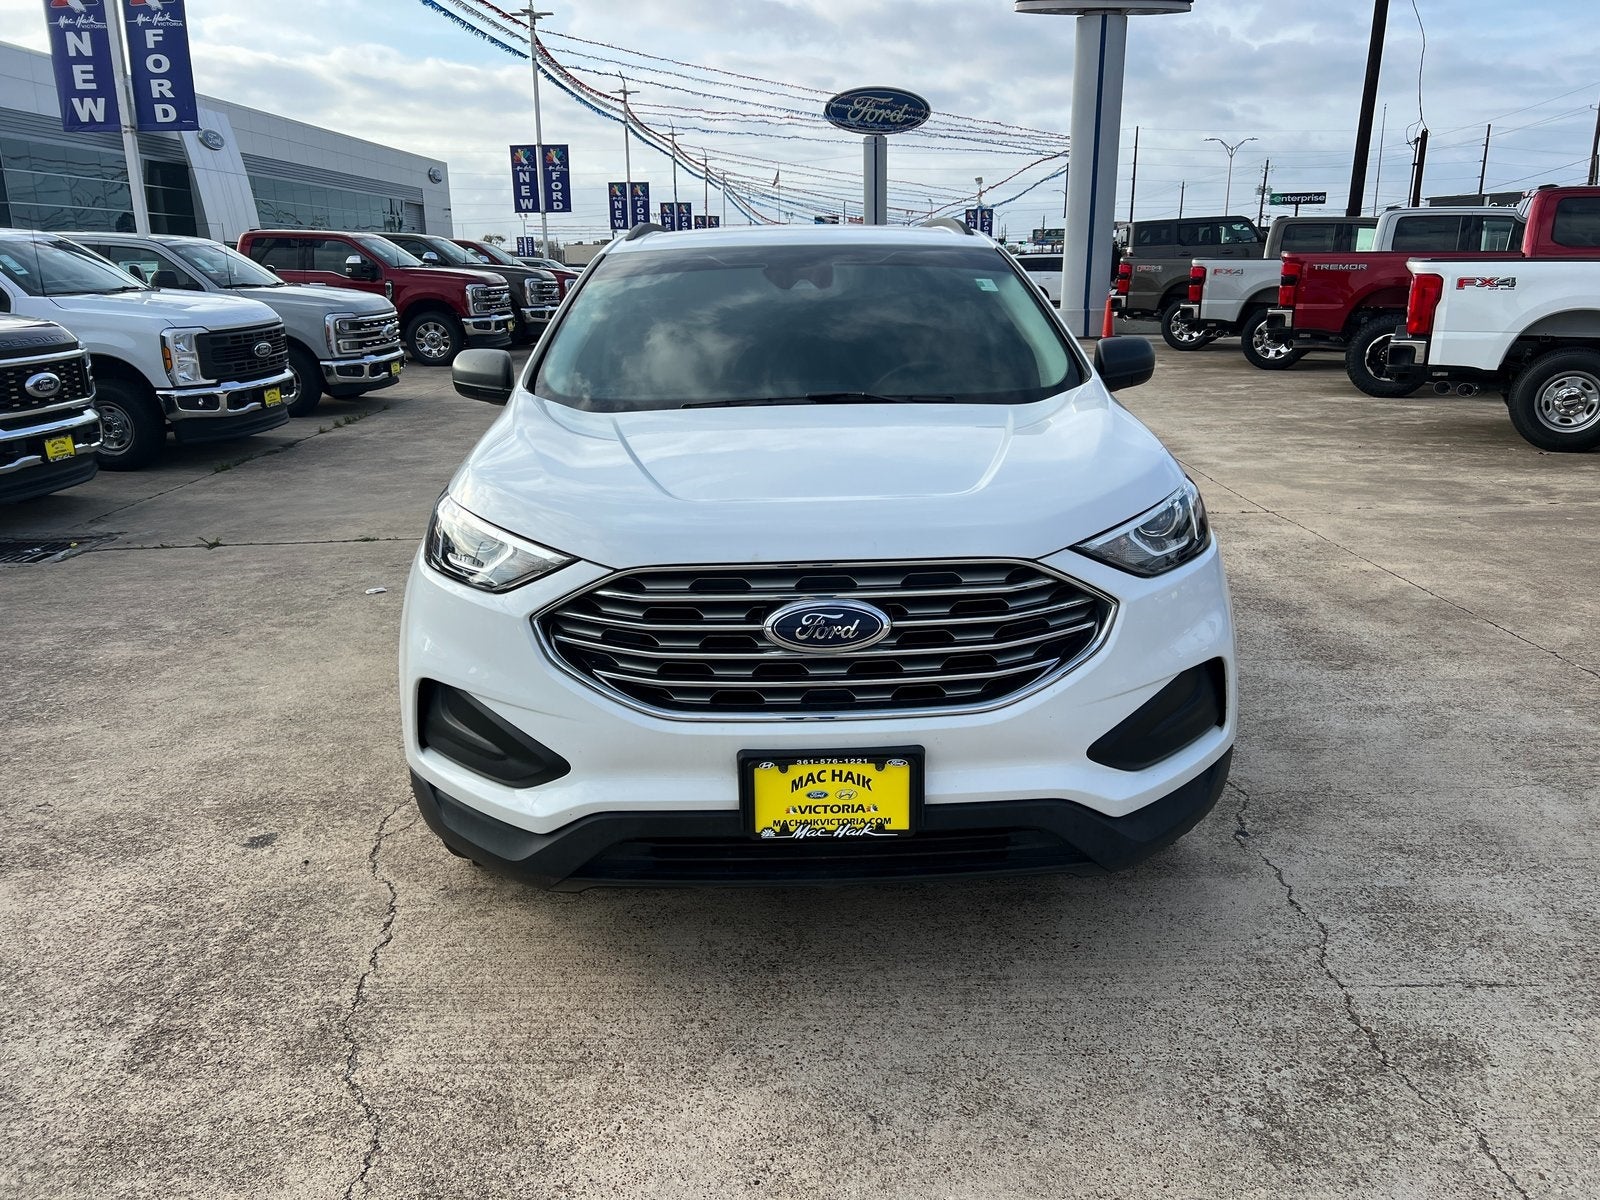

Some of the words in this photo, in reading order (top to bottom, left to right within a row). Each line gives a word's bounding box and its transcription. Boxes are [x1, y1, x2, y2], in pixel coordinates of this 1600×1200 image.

[58, 15, 76, 28] Mac
[137, 13, 152, 26] Mac
[65, 31, 105, 122] NEW
[145, 29, 177, 123] FORD
[847, 95, 909, 122] Ford
[519, 171, 533, 210] NEW
[551, 171, 563, 210] FORD
[1271, 194, 1326, 203] enterprise
[614, 200, 624, 228] NEW
[637, 200, 645, 223] FOR
[1214, 268, 1244, 276] FX4
[1456, 276, 1516, 290] FX4
[795, 612, 861, 640] Ford
[791, 769, 827, 793] MAC
[831, 769, 872, 791] HAIK
[798, 804, 866, 814] VICTORIA
[791, 824, 828, 839] Mac
[833, 823, 876, 838] Haik
